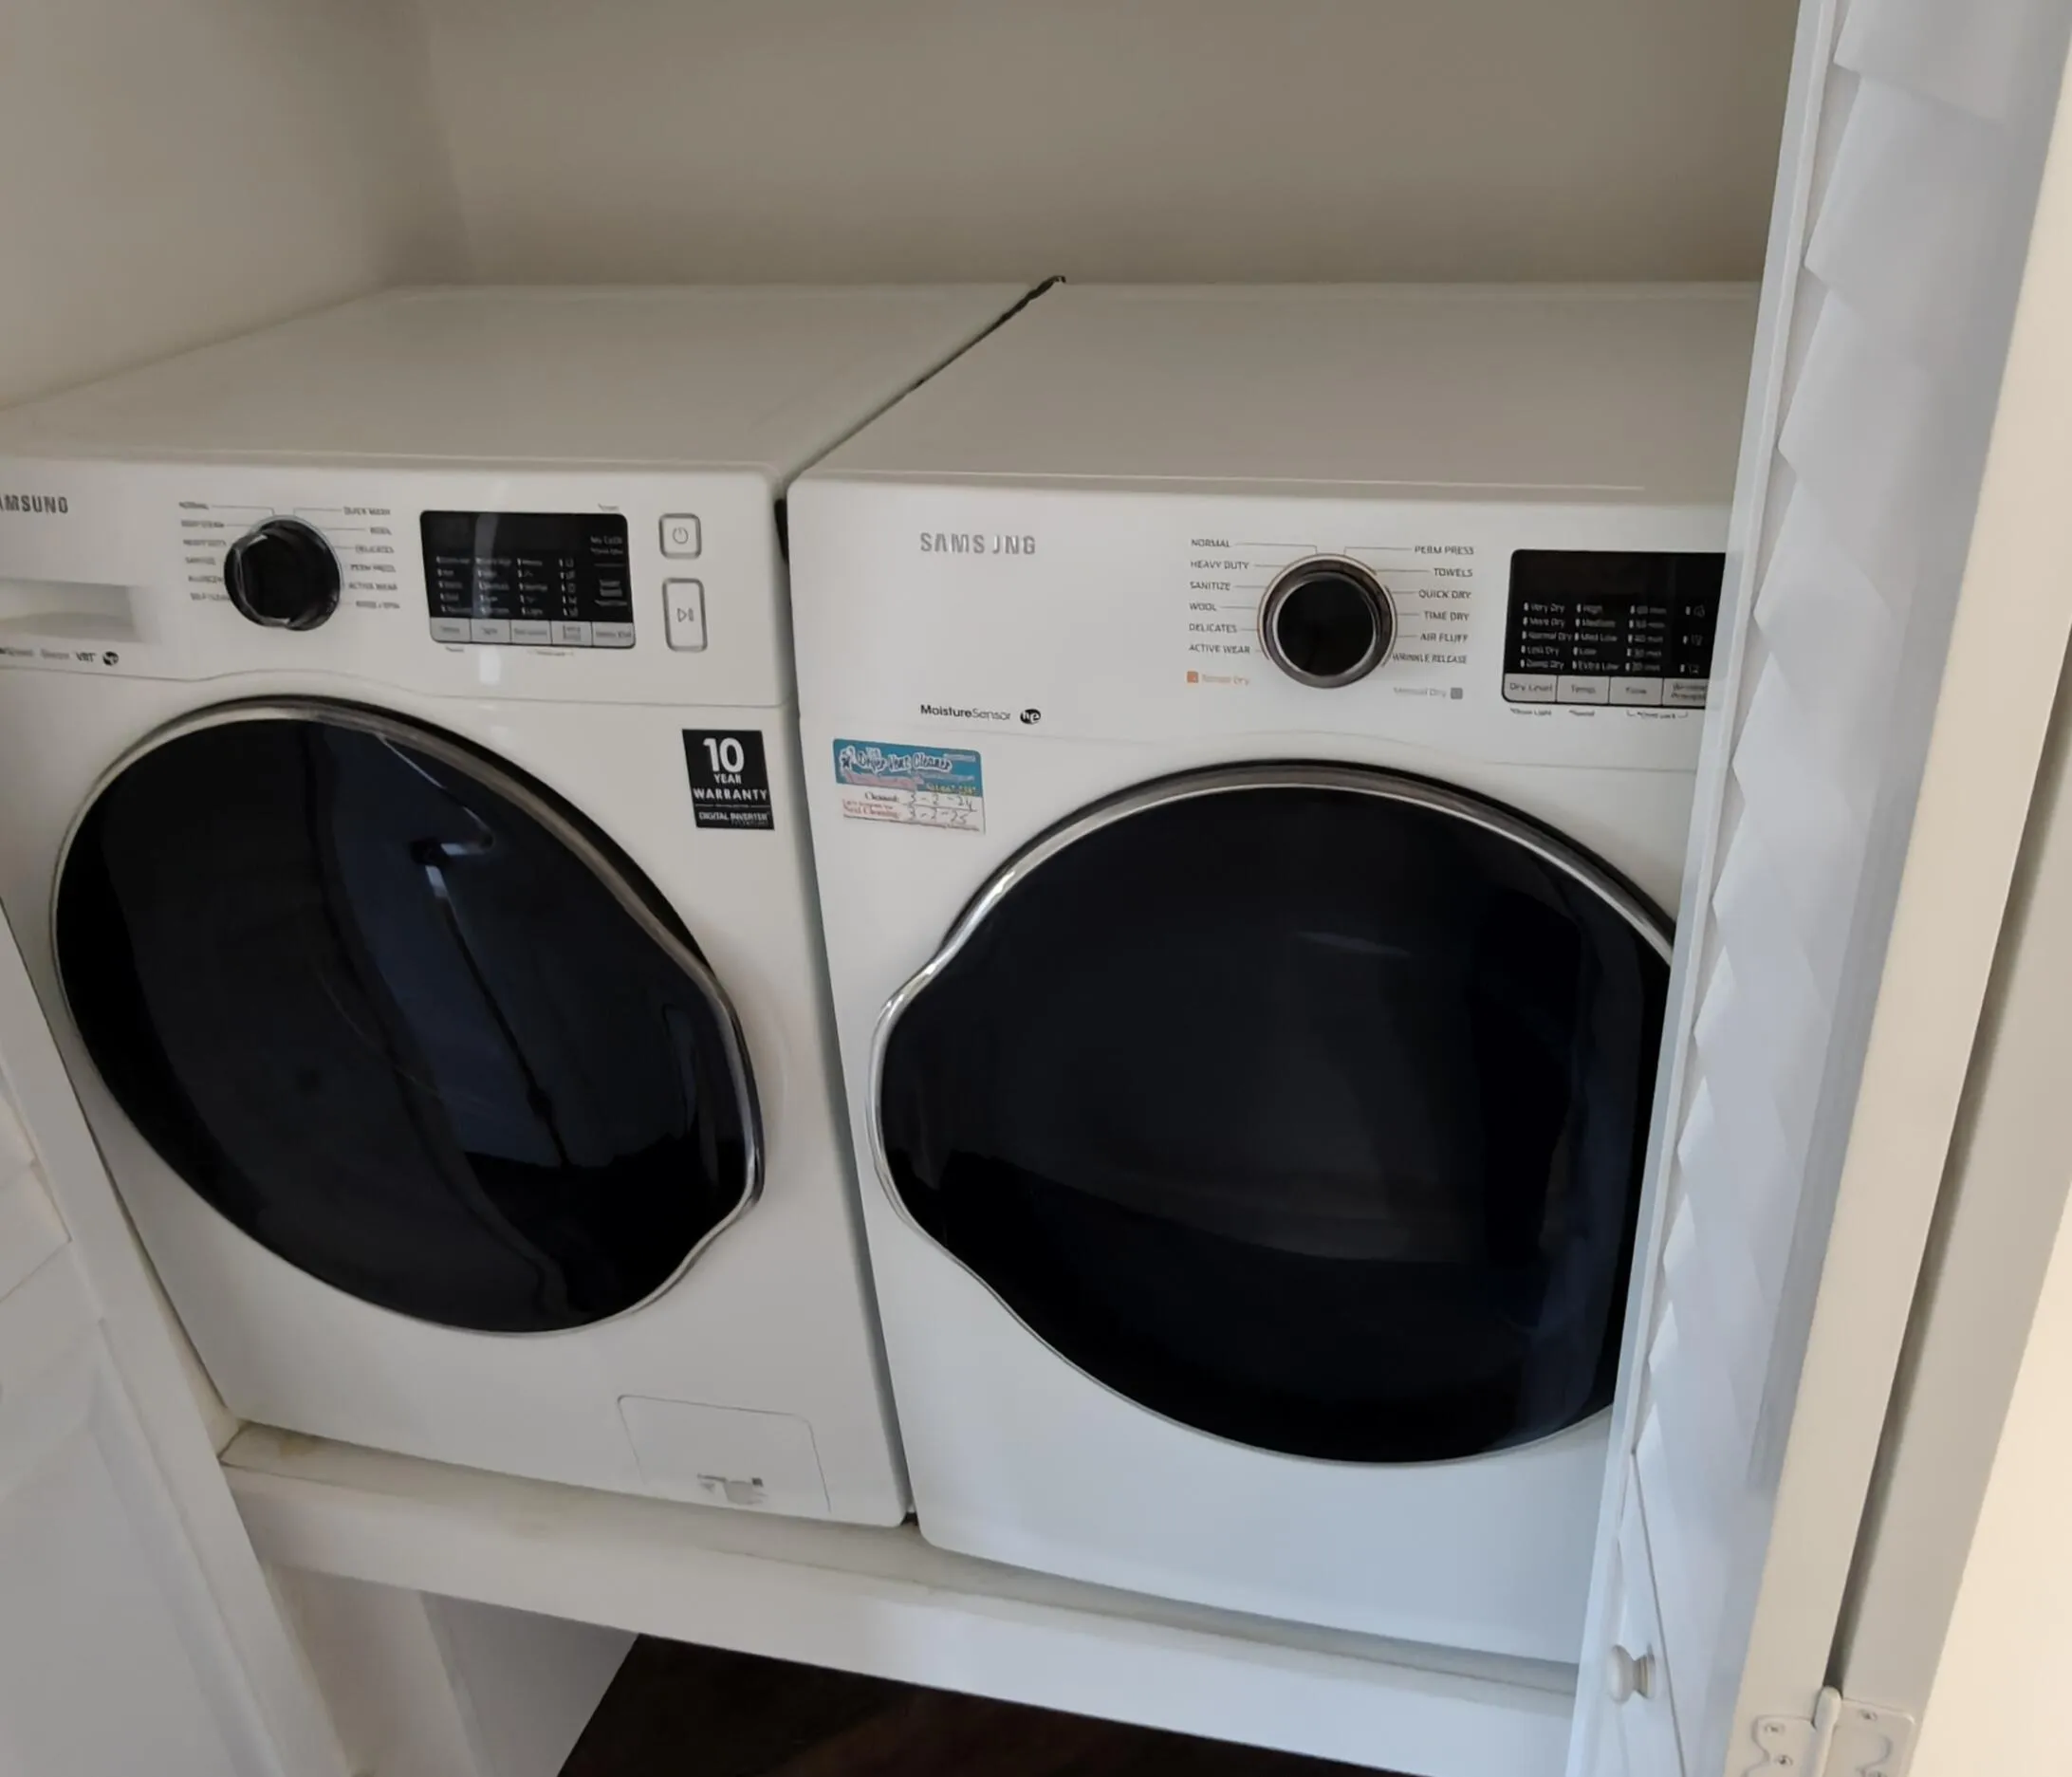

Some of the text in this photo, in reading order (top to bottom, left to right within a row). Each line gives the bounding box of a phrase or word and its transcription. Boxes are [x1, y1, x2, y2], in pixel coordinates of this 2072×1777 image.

[1191, 539, 1230, 547] NORMAL
[1415, 546, 1475, 555] PERM PRESS
[1190, 561, 1249, 570] HEAVY DUTY
[1434, 568, 1473, 578] TOWELS
[1190, 582, 1230, 591] SANITIZE
[1418, 589, 1472, 600] QUICK DRY
[1189, 602, 1217, 612] WOOL
[1423, 611, 1471, 621] TIME DRY
[1189, 623, 1237, 633] DELICATES
[1420, 633, 1469, 643] AIR FLUFF
[1189, 644, 1250, 654] ACTIVE WEAR
[1392, 653, 1468, 664] WRINKLE RELEASE
[919, 704, 1010, 721] MoistureSensor
[703, 737, 745, 772] 10
[713, 773, 742, 784] YEAR
[693, 787, 768, 801] WARRANTY
[698, 811, 729, 821] DIGITAL
